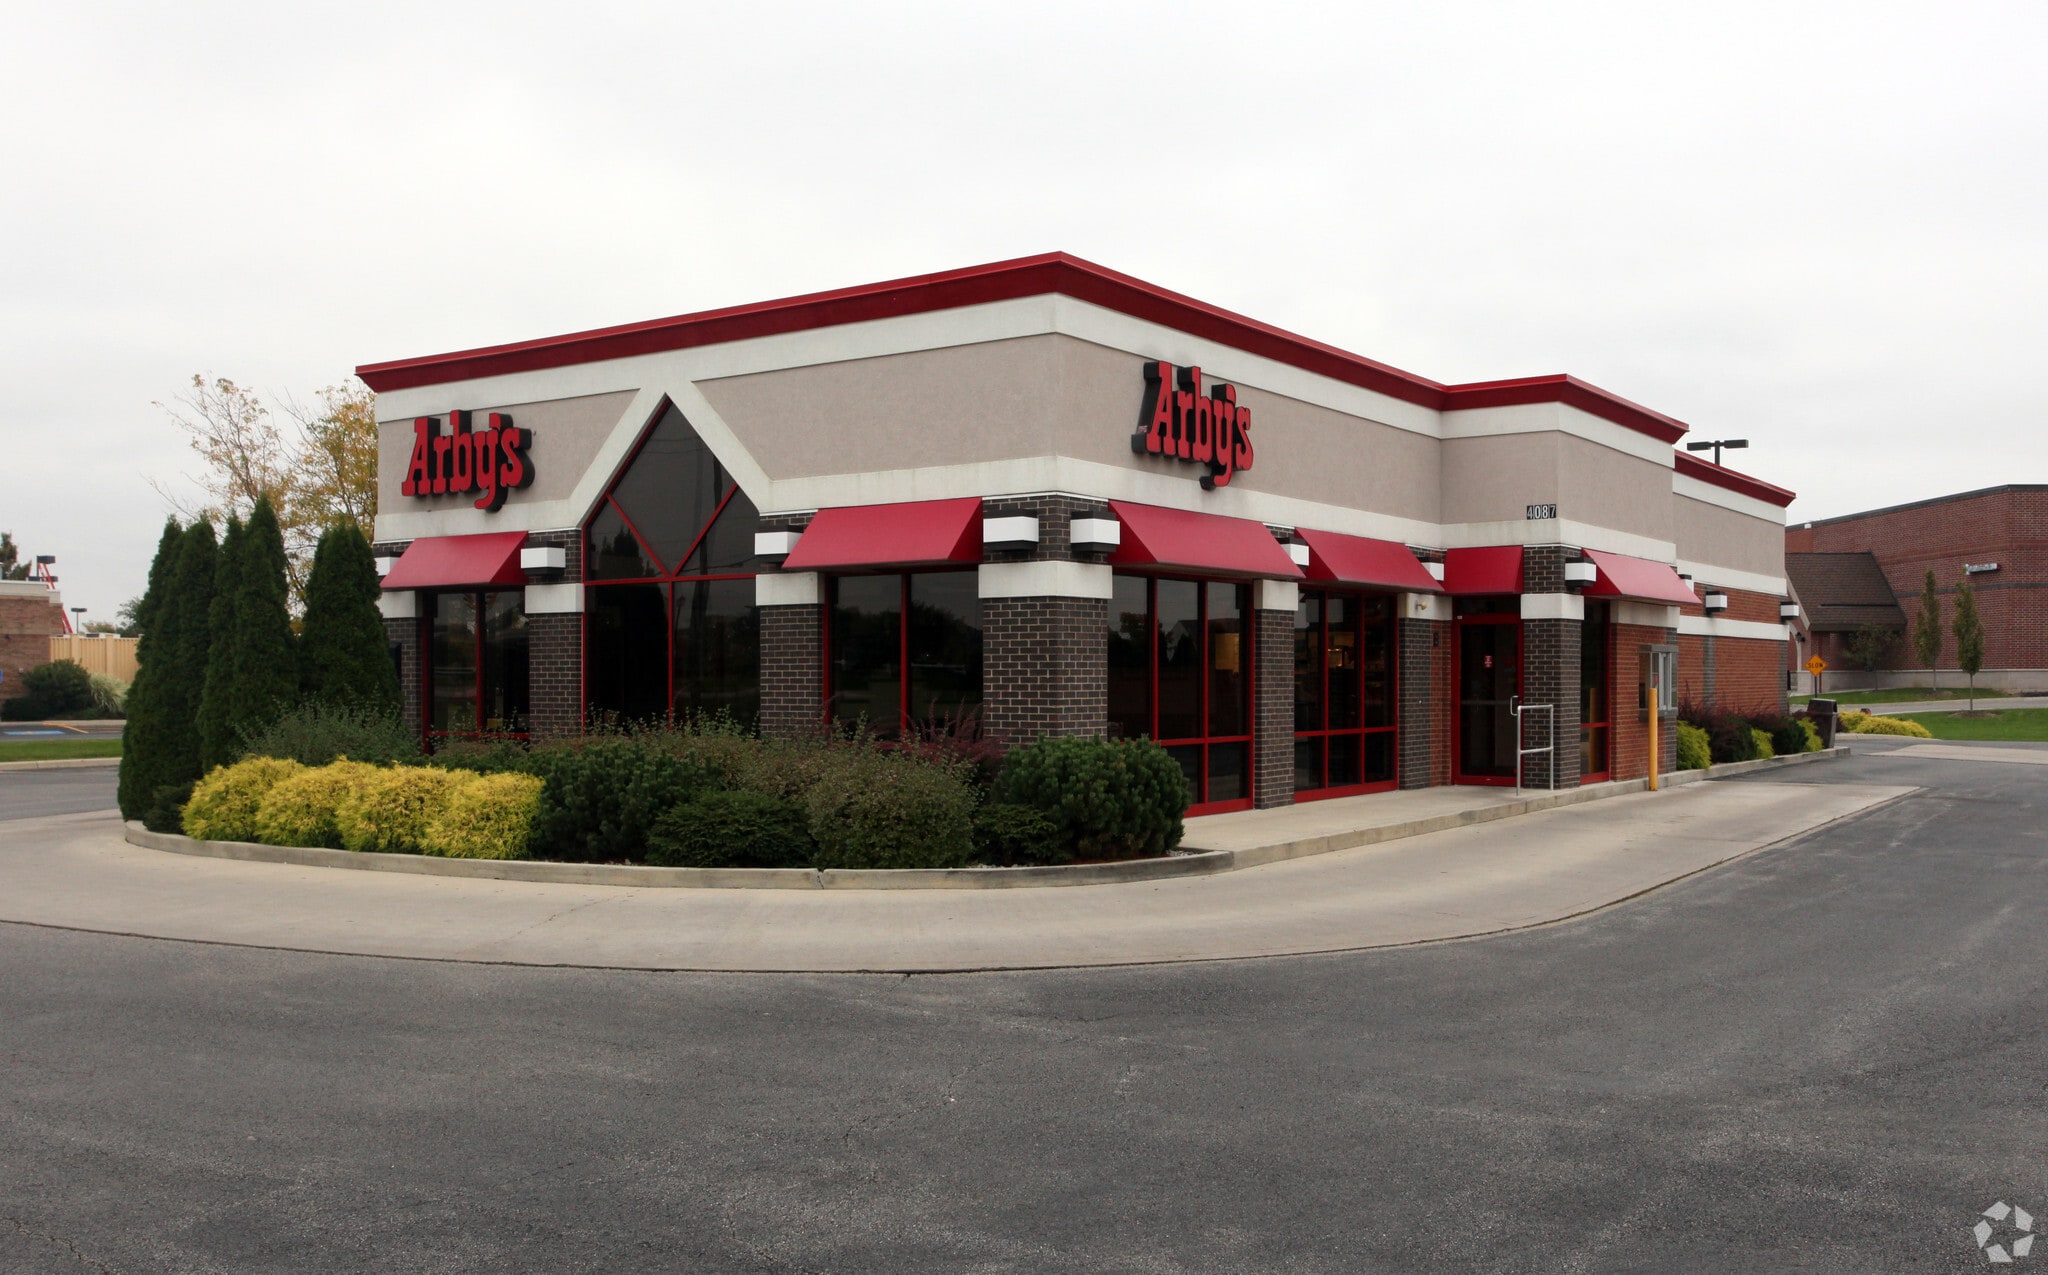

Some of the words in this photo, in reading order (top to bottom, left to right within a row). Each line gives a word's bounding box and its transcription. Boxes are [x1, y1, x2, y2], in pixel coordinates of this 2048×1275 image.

[401, 409, 524, 510] Arby's
[1146, 360, 1254, 487] Arby's
[1527, 504, 1556, 519] 4087
